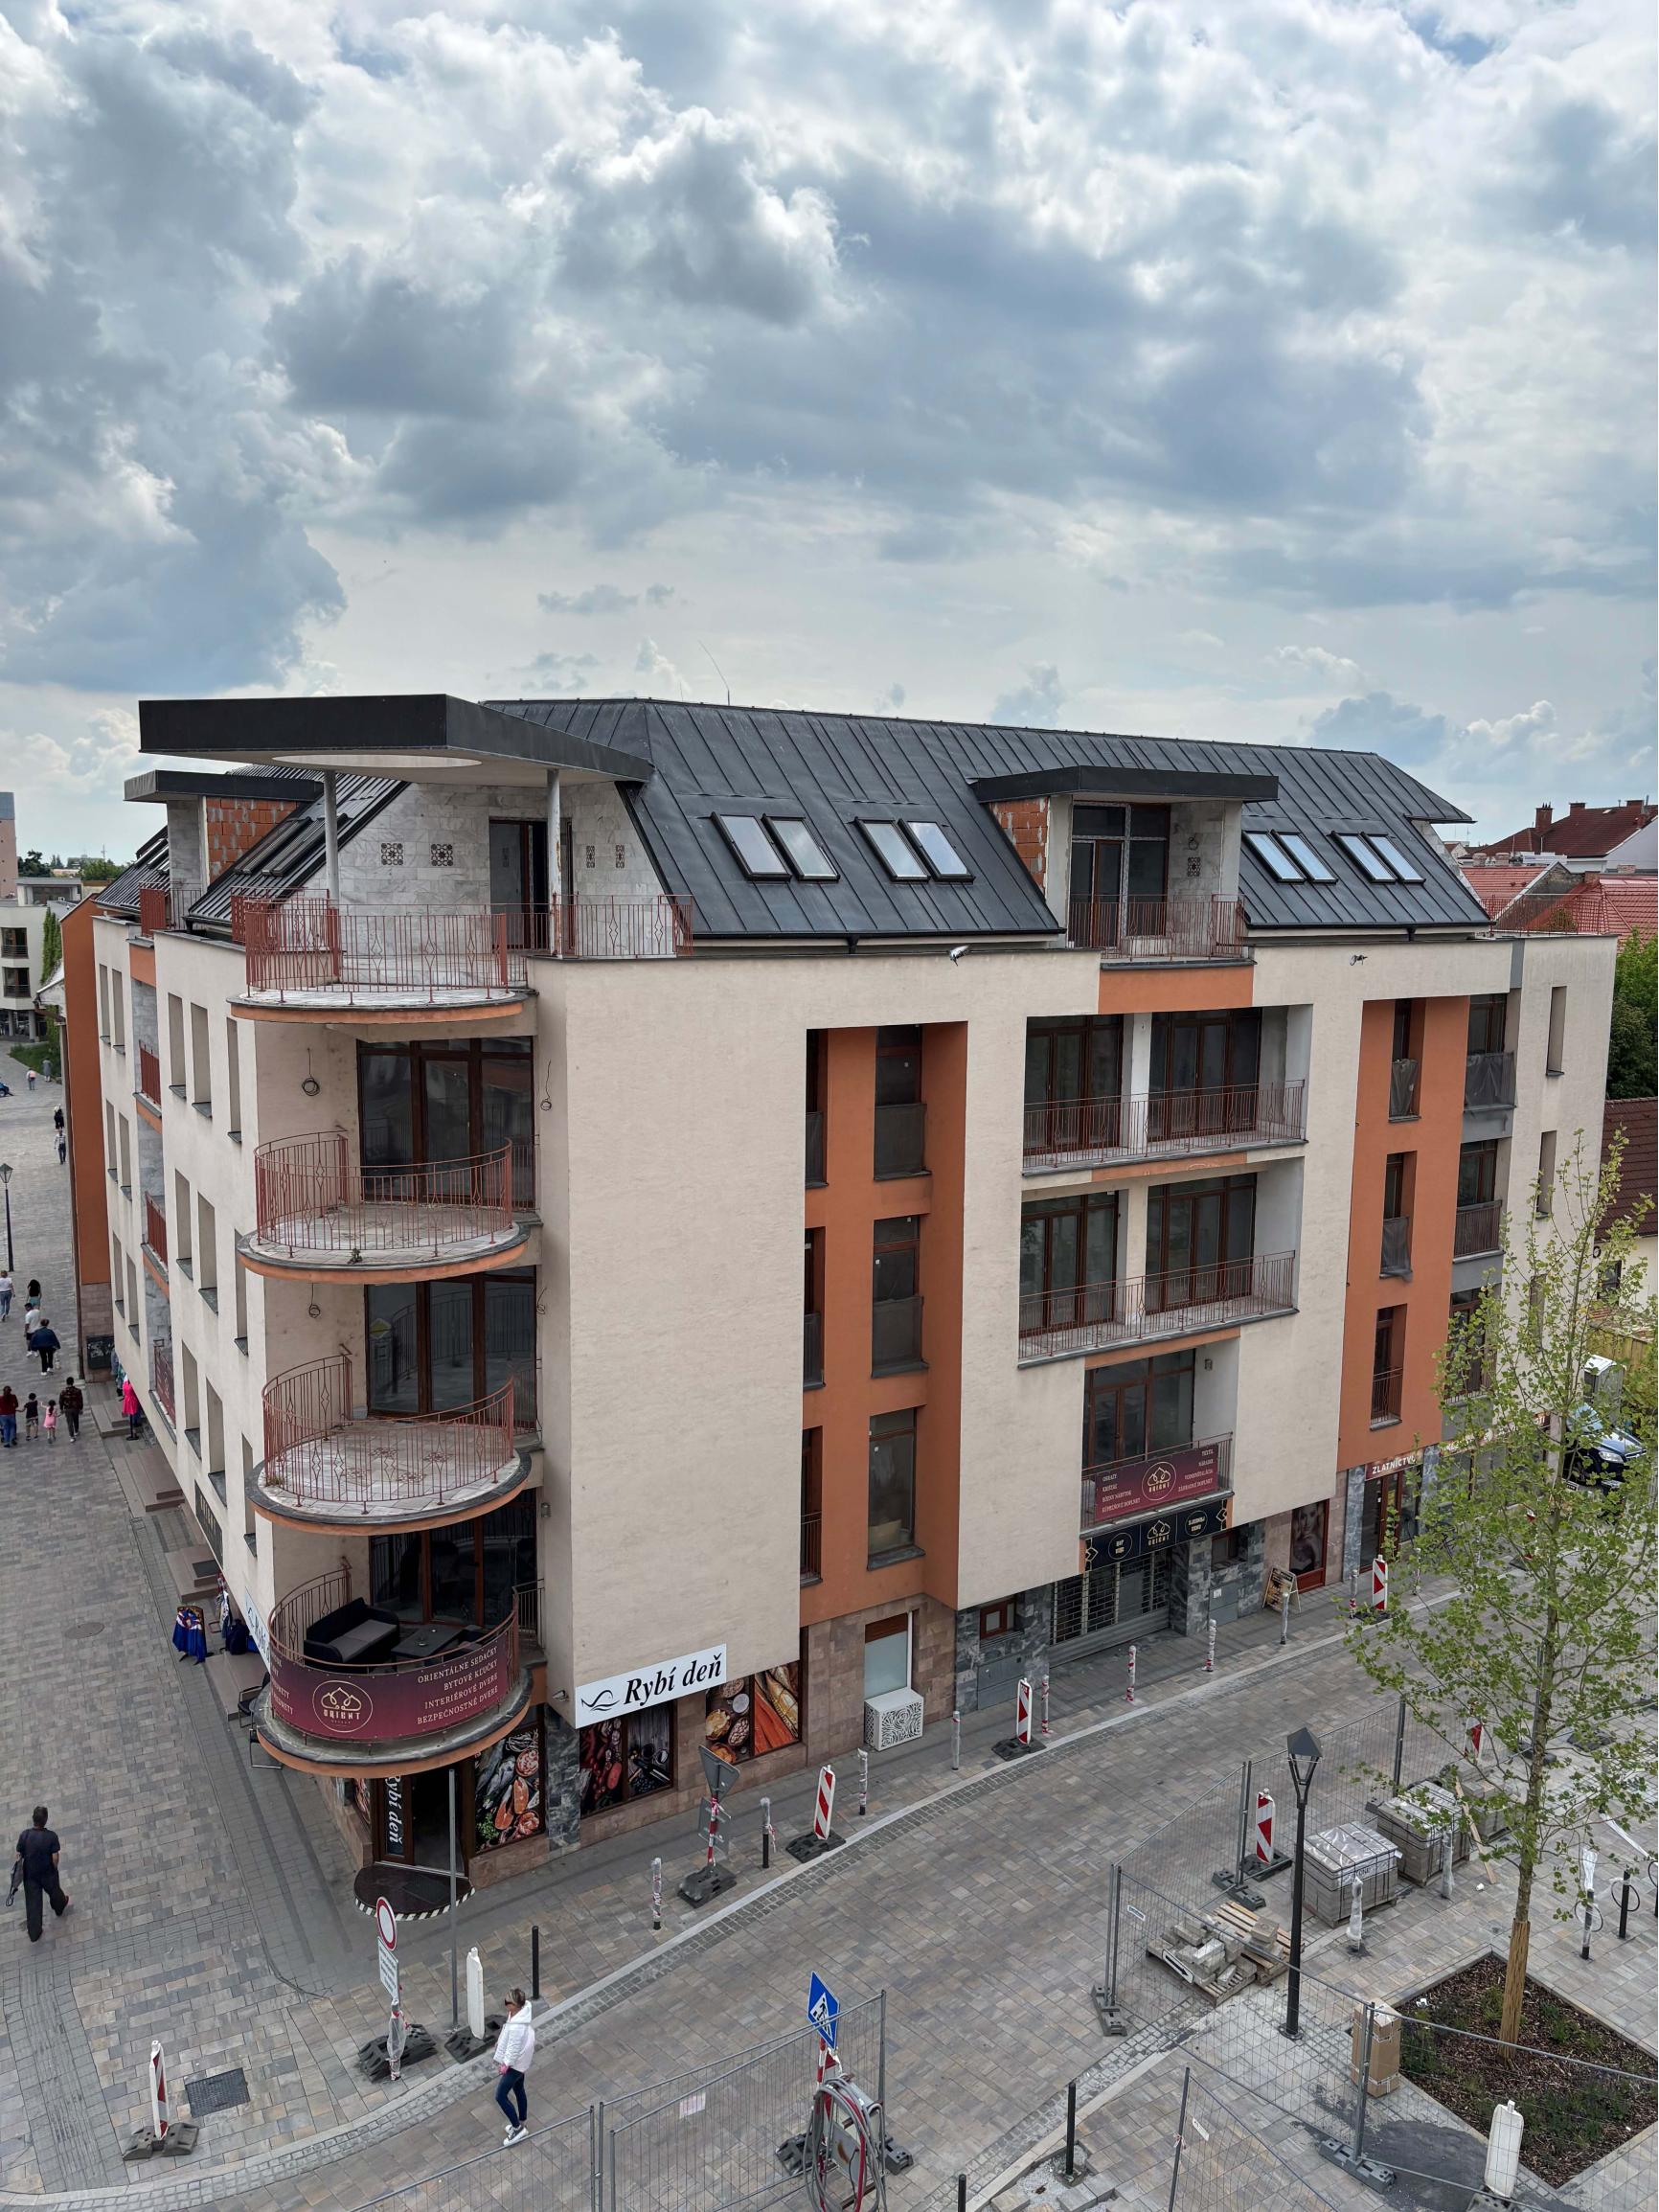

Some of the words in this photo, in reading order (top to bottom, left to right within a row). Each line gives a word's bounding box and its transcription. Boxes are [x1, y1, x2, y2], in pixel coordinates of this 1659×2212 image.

[417, 1661, 469, 1684] ORIENTÁLNE
[470, 1645, 498, 1667] SEDAČKY
[443, 1673, 473, 1691] BYTOVÉ
[624, 1666, 677, 1707] Rybí
[682, 1653, 723, 1687] deň
[417, 1698, 478, 1724] BEZPEČNOSTNÉ
[479, 1685, 498, 1703] DVERE
[424, 1683, 478, 1710] INTERIÉROVÉ
[479, 1672, 498, 1690] DVERE
[388, 1812, 403, 1846] deň
